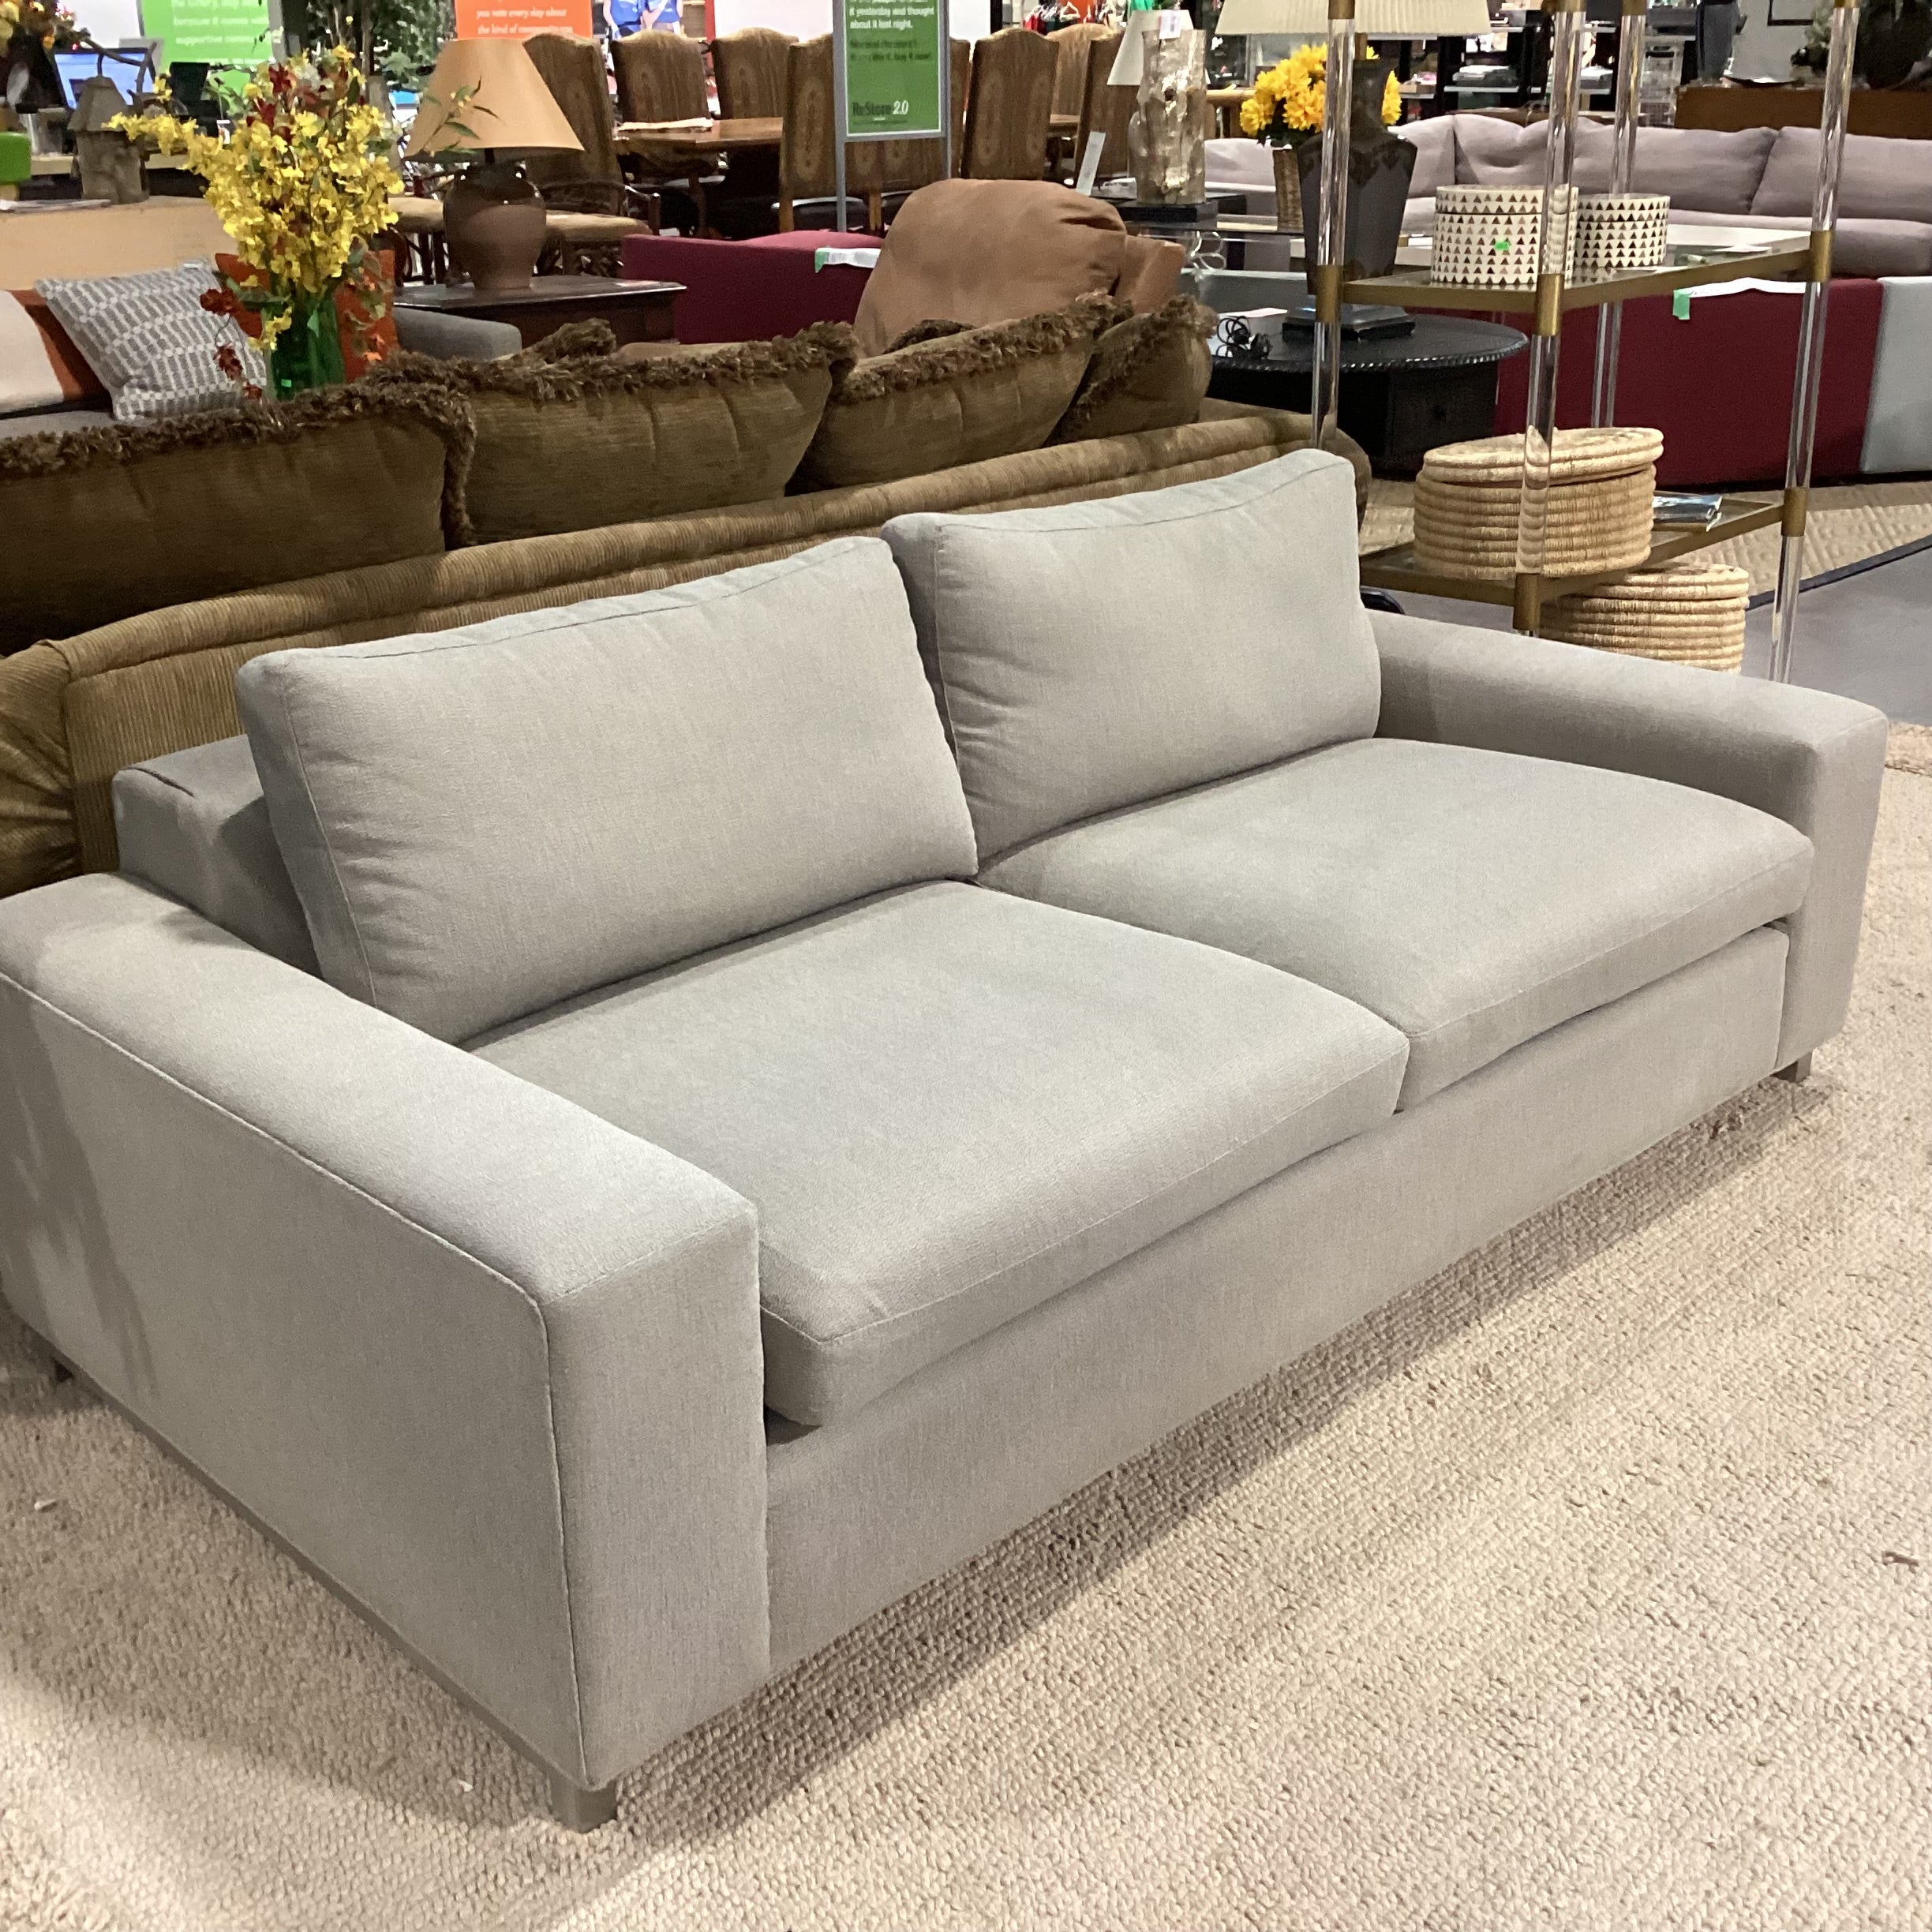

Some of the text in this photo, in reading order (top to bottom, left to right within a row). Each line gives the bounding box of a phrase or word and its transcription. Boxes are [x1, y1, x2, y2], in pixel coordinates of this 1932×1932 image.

[476, 10, 490, 20] you
[508, 9, 529, 19] every
[530, 6, 545, 19] day
[545, 6, 567, 17] about
[856, 6, 891, 17] yesterday
[892, 6, 906, 16] and
[907, 6, 934, 17] thought
[477, 24, 490, 35] the
[492, 24, 508, 34] kind
[509, 23, 519, 34] of
[850, 19, 871, 29] about
[878, 19, 892, 29] last
[893, 19, 914, 31] night.
[852, 99, 909, 116] ReStore 2.0
